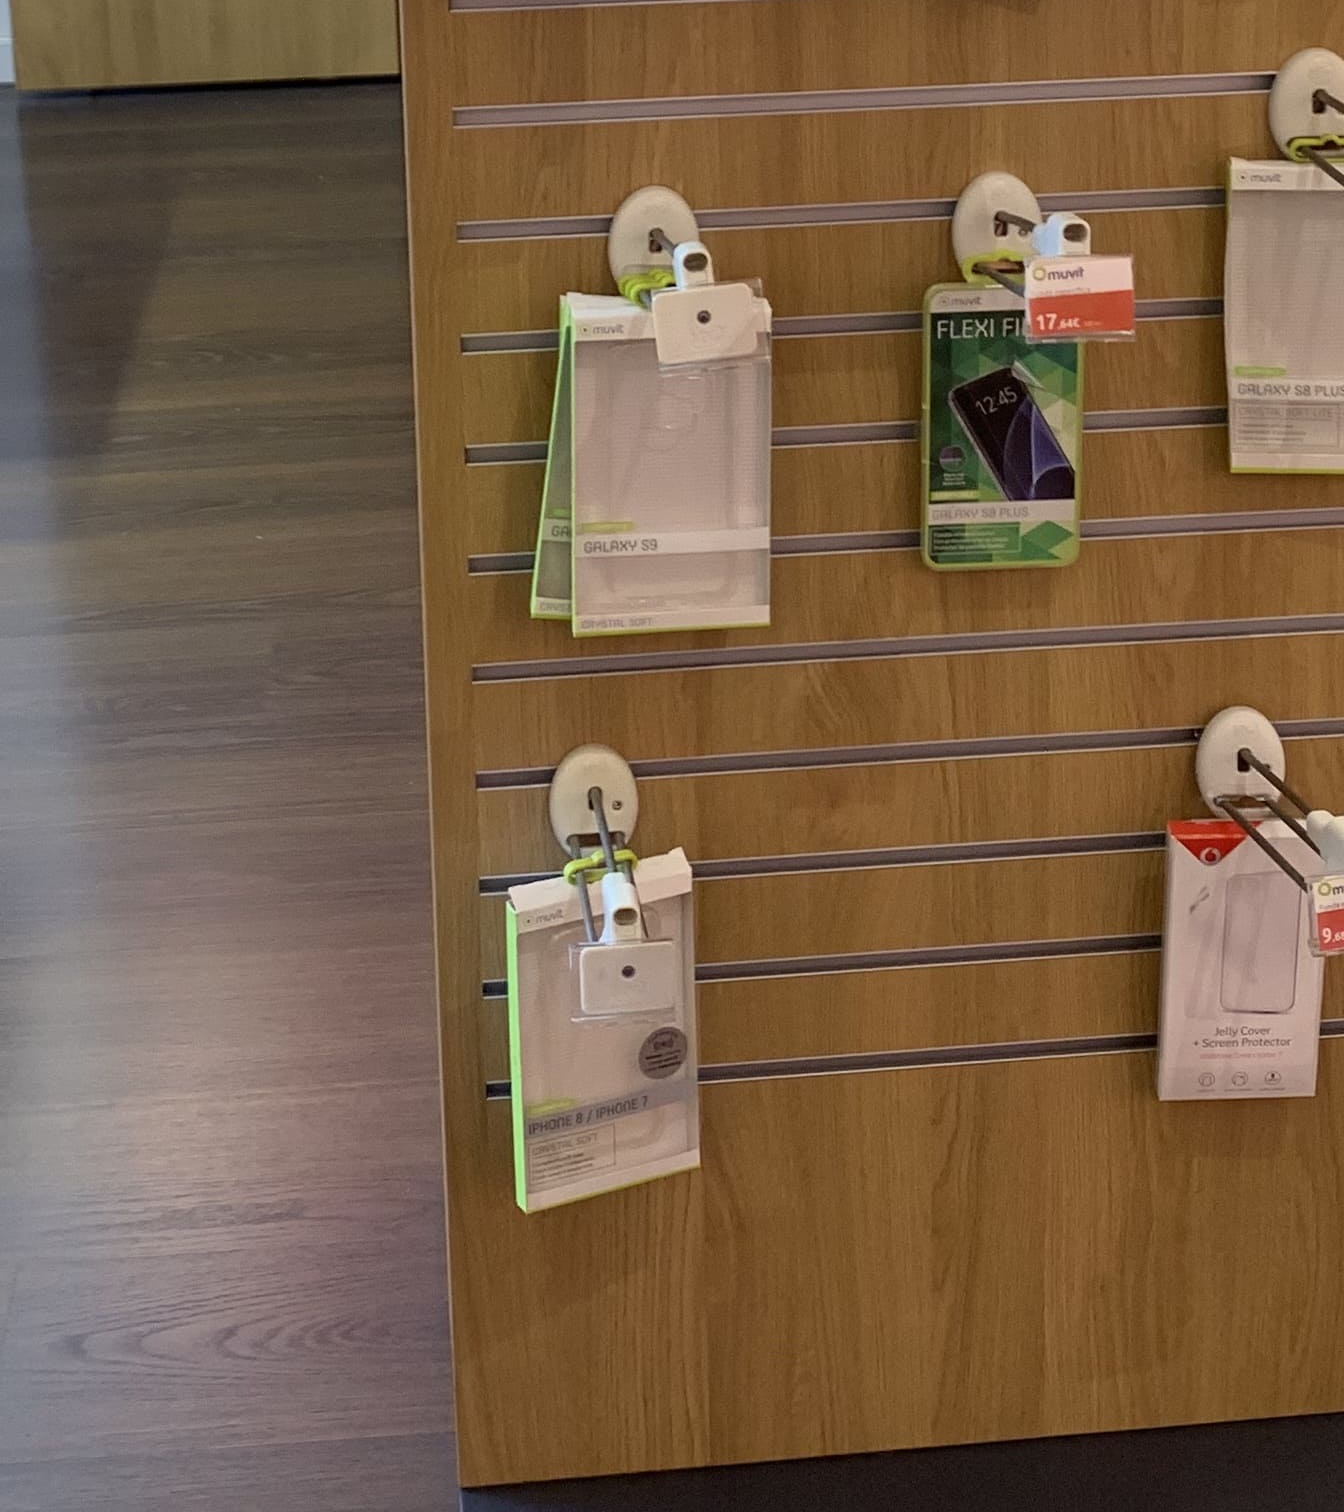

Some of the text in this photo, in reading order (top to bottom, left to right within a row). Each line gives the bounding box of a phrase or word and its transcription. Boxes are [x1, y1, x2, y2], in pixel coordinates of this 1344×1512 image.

[1249, 172, 1281, 184] muvit
[1047, 266, 1084, 280] muvit
[952, 296, 982, 305] muvit
[592, 323, 624, 335] muvit
[937, 317, 1025, 339] FLEXI FI
[1238, 383, 1291, 396] GALAXY
[975, 386, 1017, 415] 12:45
[932, 509, 978, 521] GALAXY
[999, 506, 1029, 518] PLUS
[584, 539, 657, 553] GALAXY S9
[581, 617, 625, 629] CRYSTAL
[535, 909, 564, 924] muvit
[1216, 1026, 1271, 1037] Jelly Cover
[1202, 1038, 1239, 1048] Screen
[1241, 1038, 1291, 1047] Protector
[528, 1114, 572, 1135] IPHONE
[575, 1112, 583, 1124] 8
[596, 1099, 638, 1119] IPHONE
[642, 1096, 648, 1107] 7
